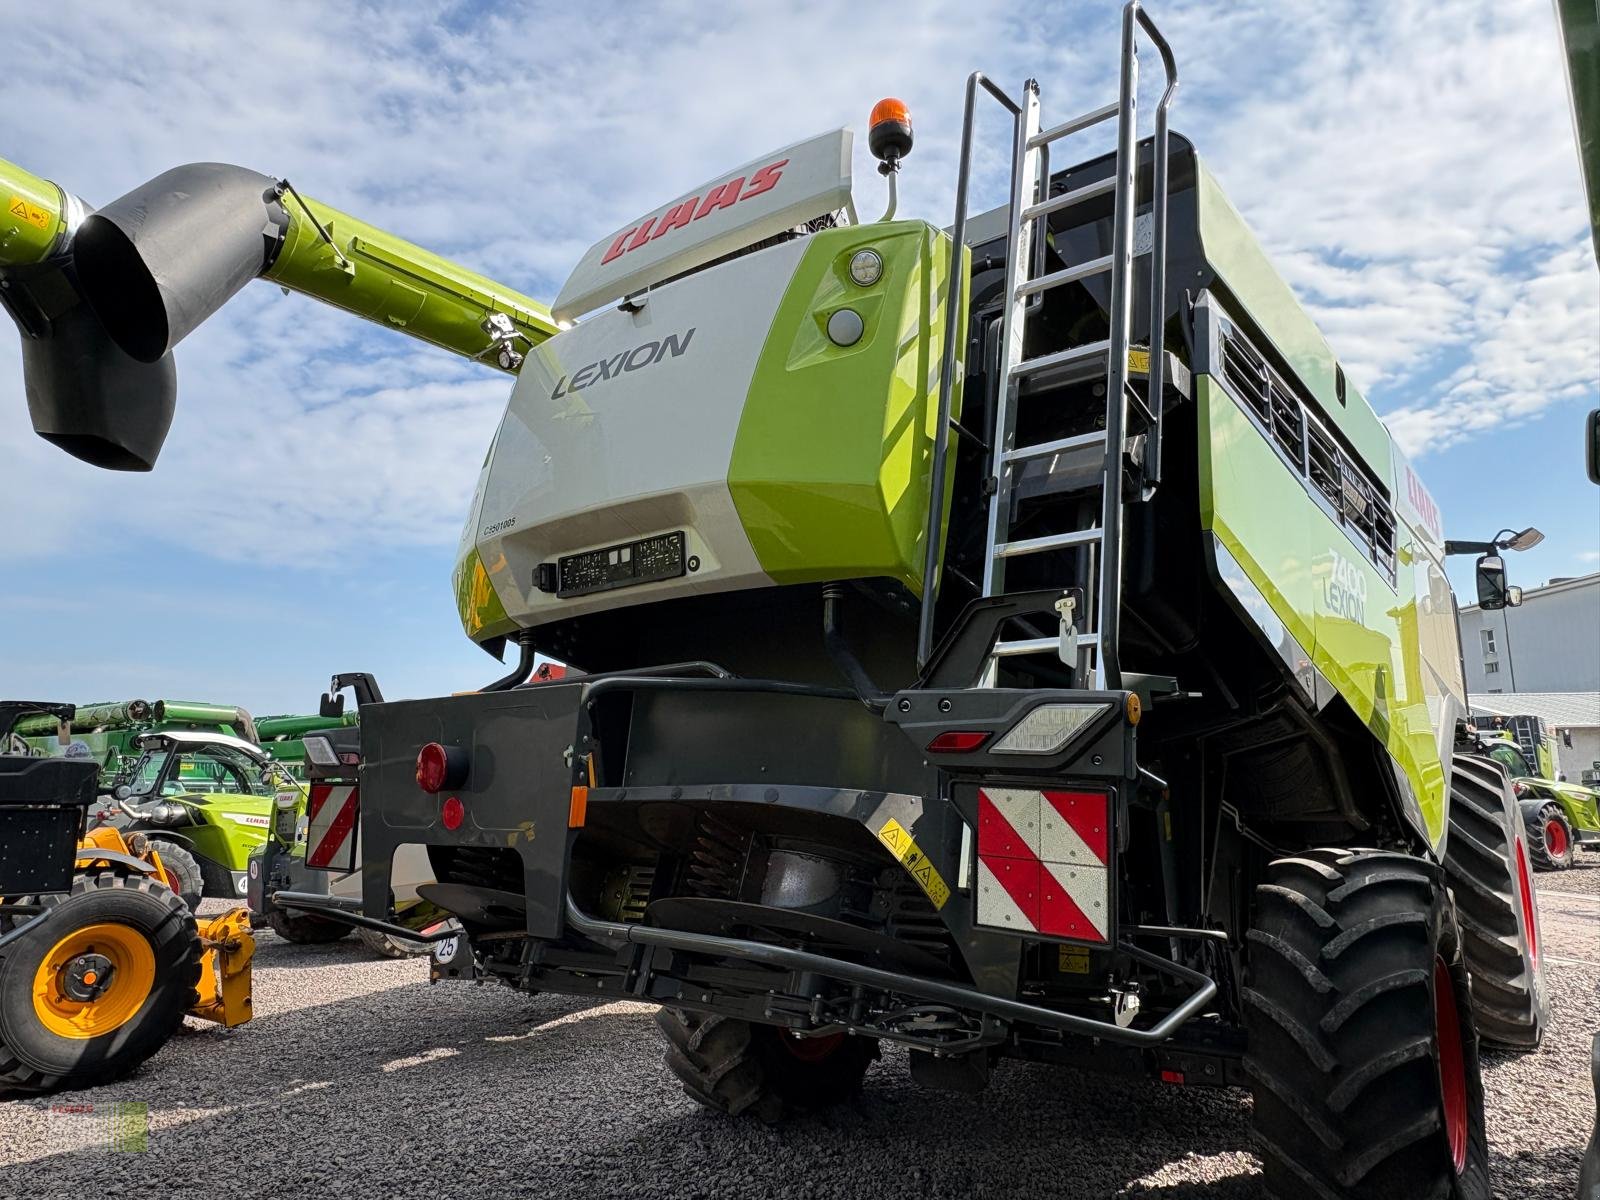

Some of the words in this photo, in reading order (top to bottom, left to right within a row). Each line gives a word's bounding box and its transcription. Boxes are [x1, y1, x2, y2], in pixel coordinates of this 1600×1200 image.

[601, 159, 790, 266] CLAAS
[550, 327, 697, 401] LEXION
[1322, 575, 1365, 628] LEXION
[1329, 547, 1367, 604] 7400
[246, 817, 269, 826] CLAAS
[439, 938, 454, 957] 25
